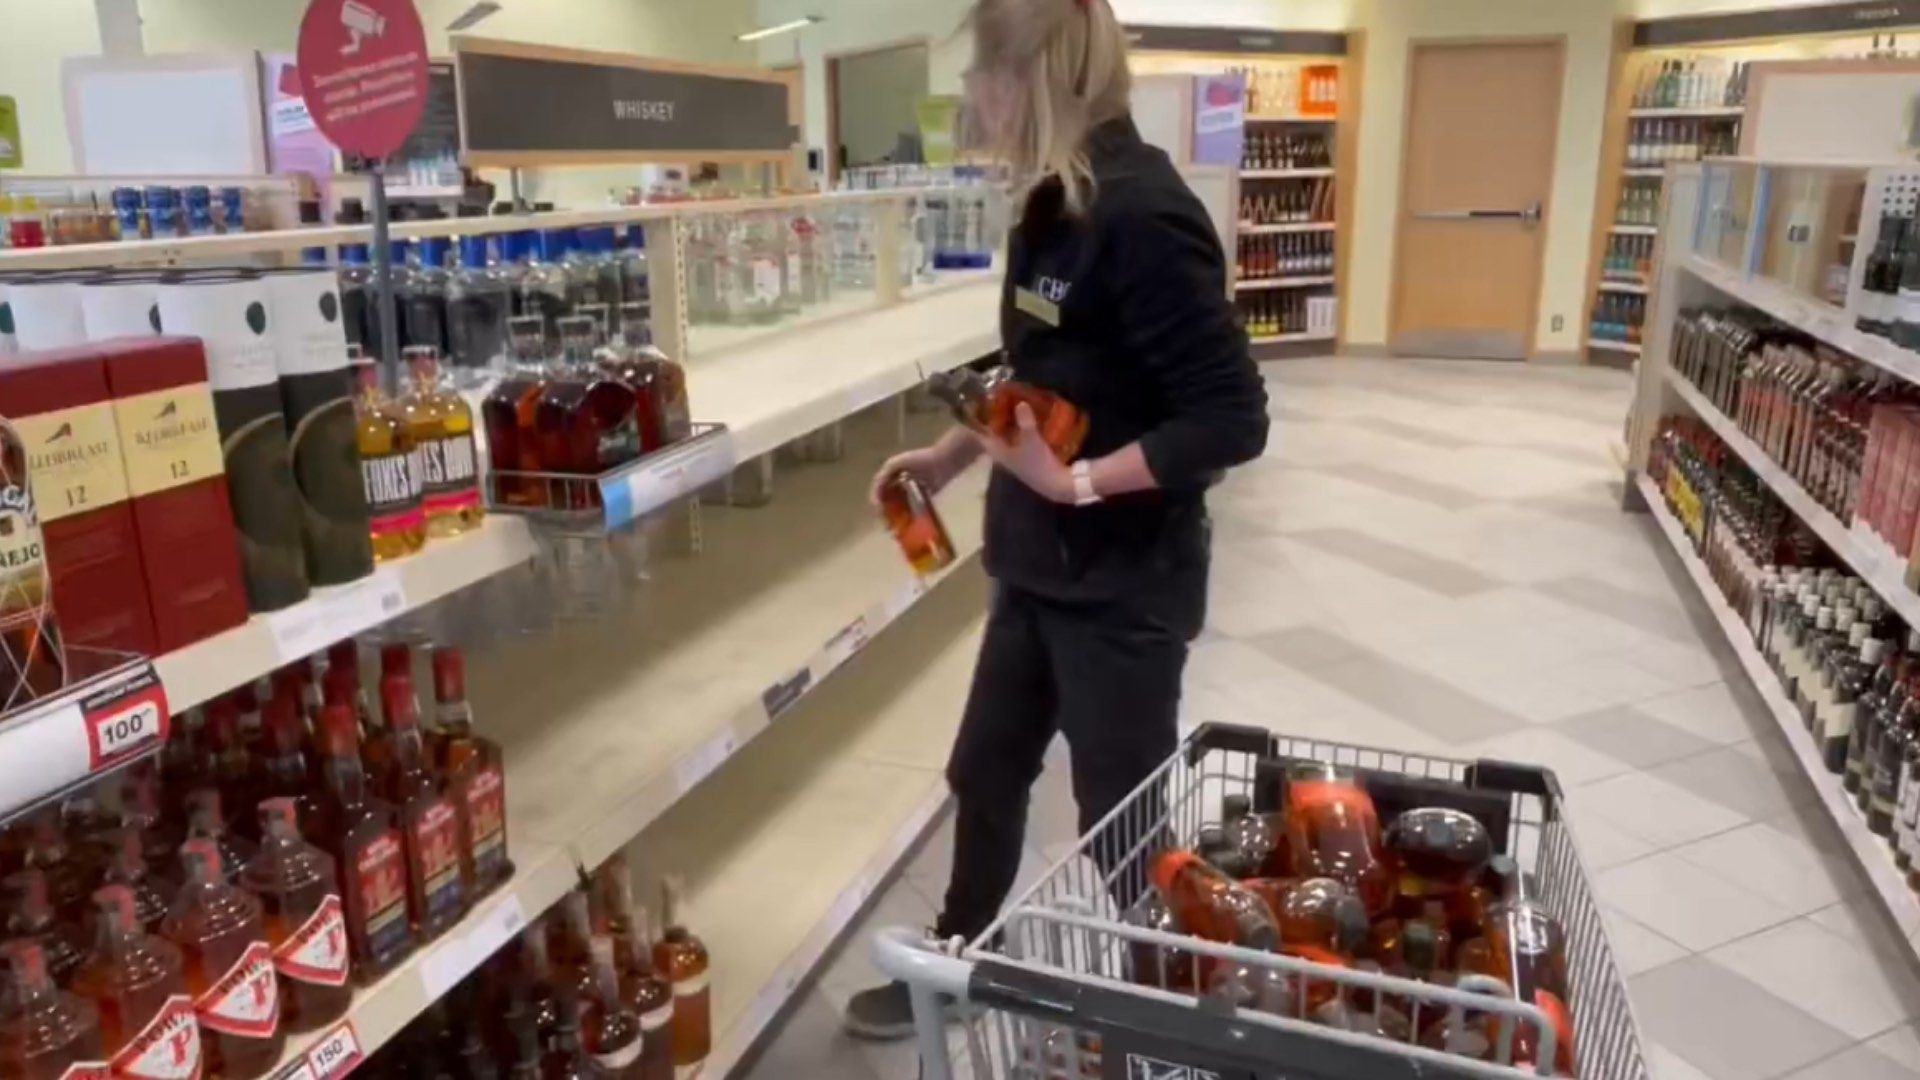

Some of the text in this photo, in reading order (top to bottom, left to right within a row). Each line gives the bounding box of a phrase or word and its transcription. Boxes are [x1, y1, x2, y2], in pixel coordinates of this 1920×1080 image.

[613, 100, 676, 121] WHISKEY
[170, 460, 189, 479] 12
[66, 485, 88, 507] 12
[104, 714, 143, 744] 100
[317, 1039, 344, 1067] 150
